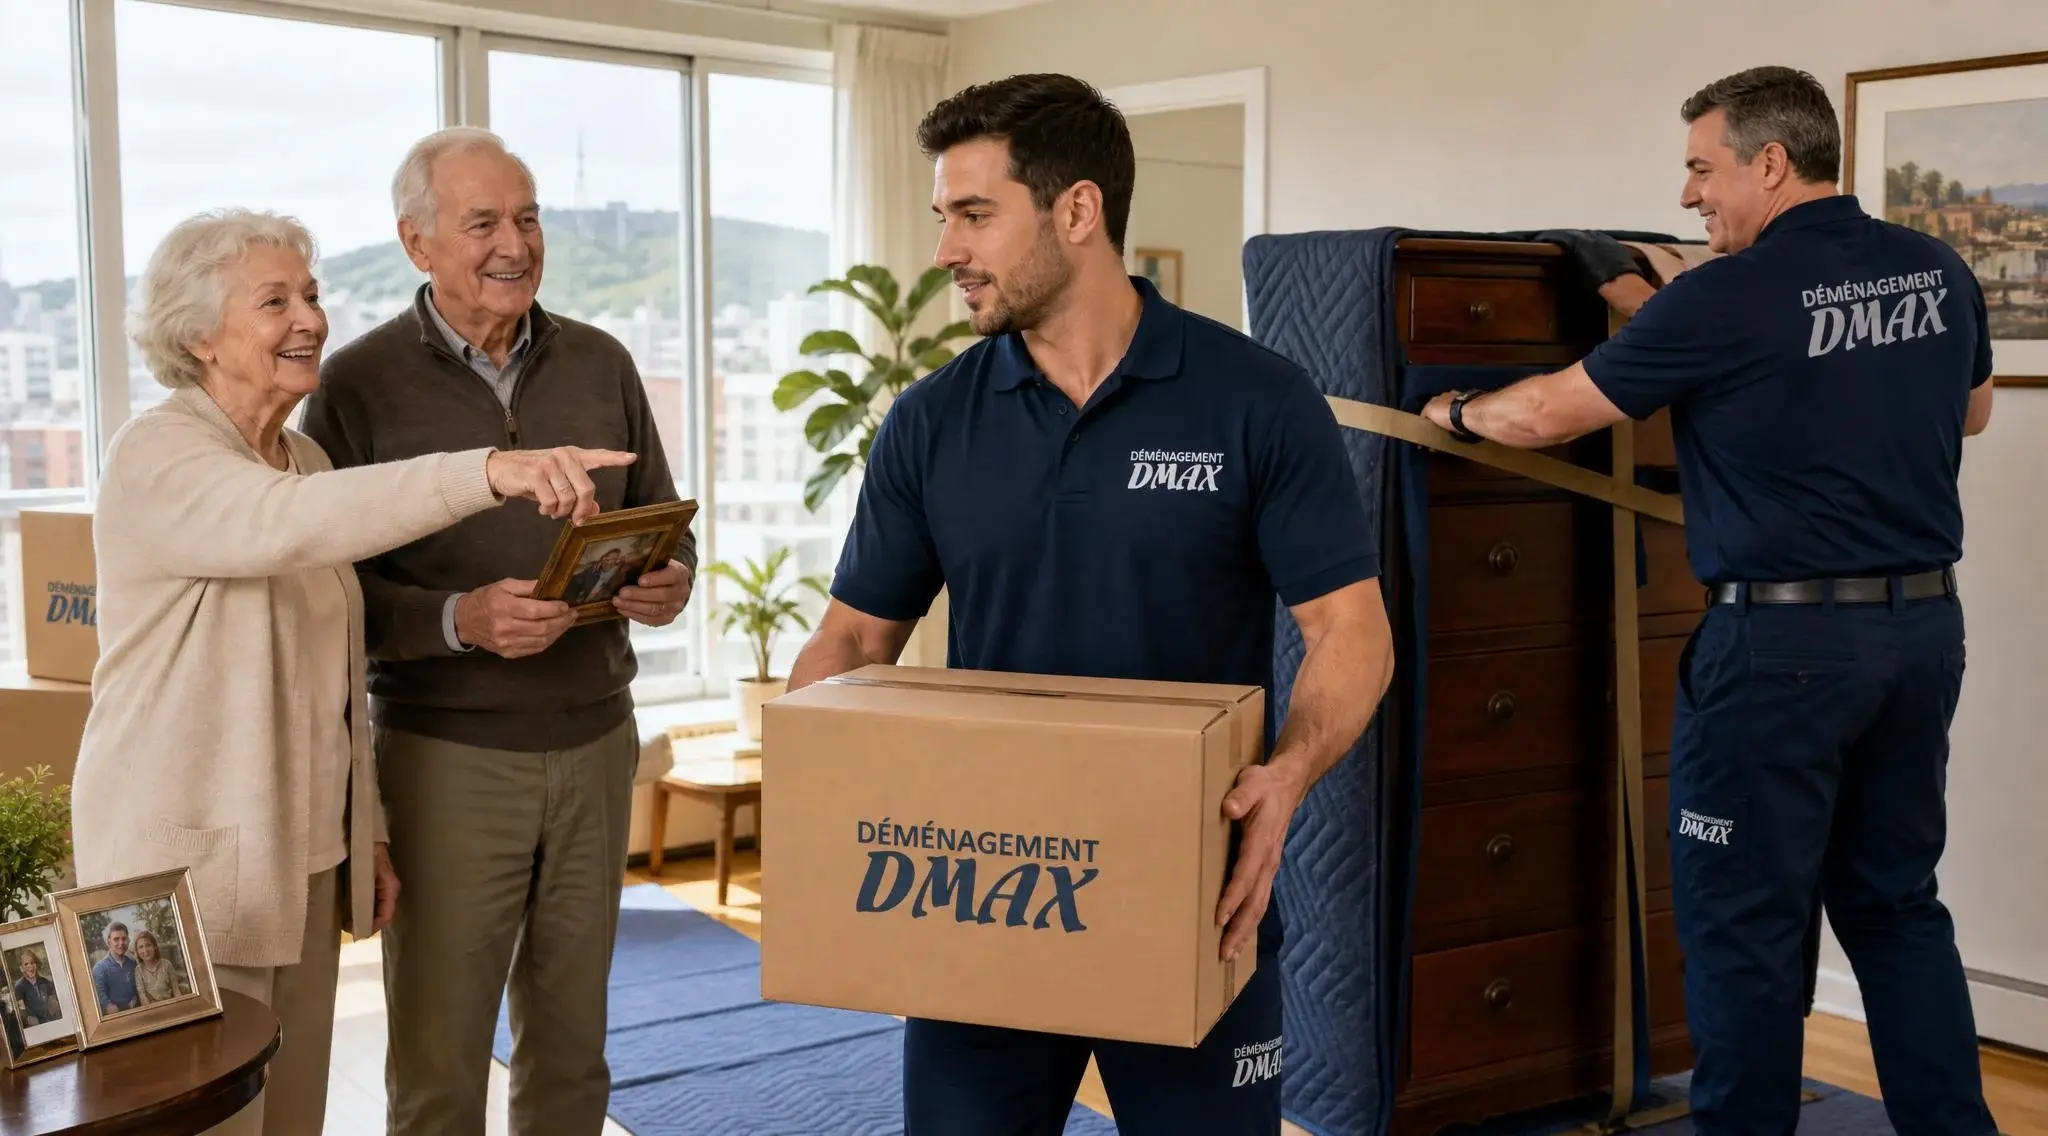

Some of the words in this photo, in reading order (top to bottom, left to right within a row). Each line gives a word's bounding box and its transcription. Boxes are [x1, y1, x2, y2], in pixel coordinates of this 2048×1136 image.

[1802, 269, 1943, 308] DÉMÉNAGEMENT
[1808, 288, 1948, 358] DMAX
[1130, 449, 1224, 463] DÉMÉNAGEMENT
[1127, 462, 1223, 491] DMAX
[857, 817, 1100, 862] DÉMÉNAGEMENT
[1679, 816, 1733, 845] DMAX
[856, 850, 1100, 933] DMAX
